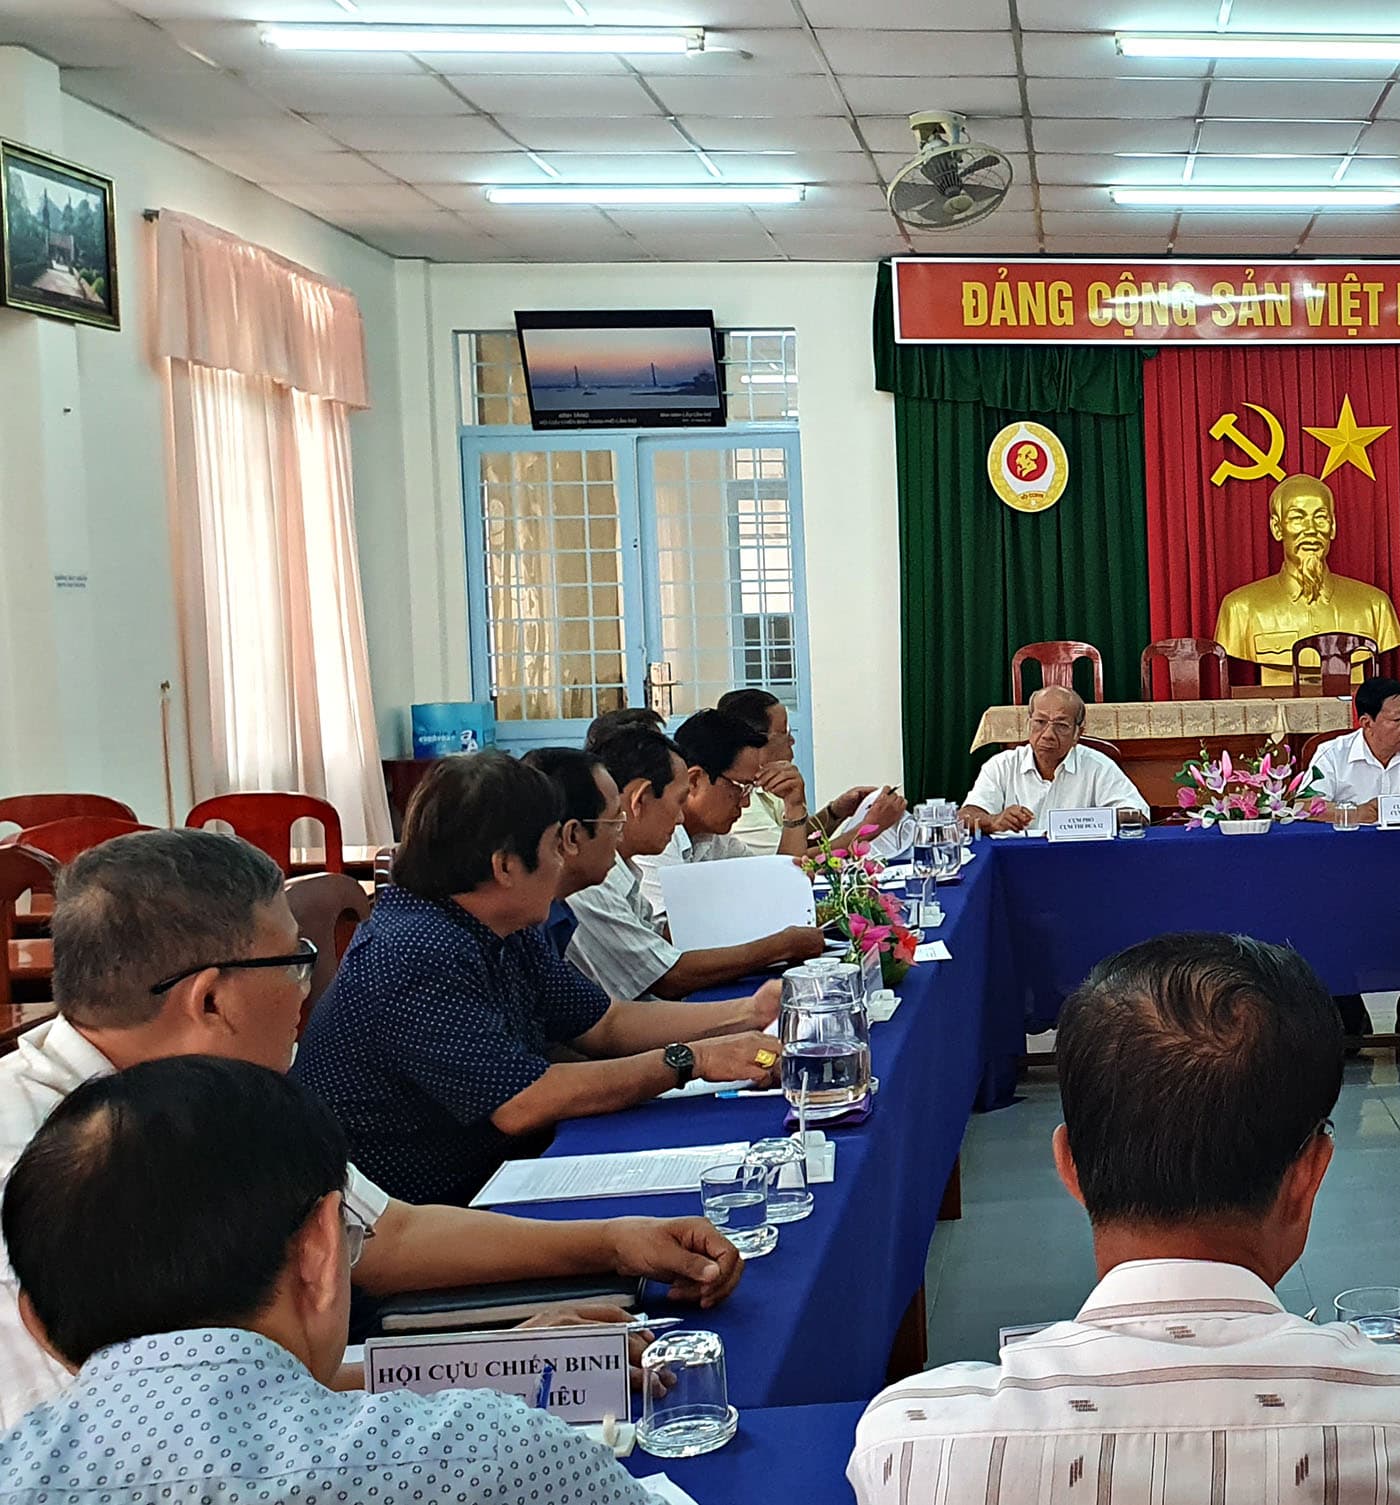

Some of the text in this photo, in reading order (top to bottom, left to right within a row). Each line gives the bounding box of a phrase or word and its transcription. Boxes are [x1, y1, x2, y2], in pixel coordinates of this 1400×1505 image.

[962, 267, 1073, 327] ĐẢNG
[1088, 271, 1196, 337] CỘNG
[1211, 268, 1292, 326] SẢN
[1304, 273, 1384, 336] VIỆT
[378, 1365, 421, 1388] HỘI
[428, 1360, 478, 1382] CỰU
[566, 1355, 619, 1372] BINH
[550, 1386, 586, 1406] IÊU
